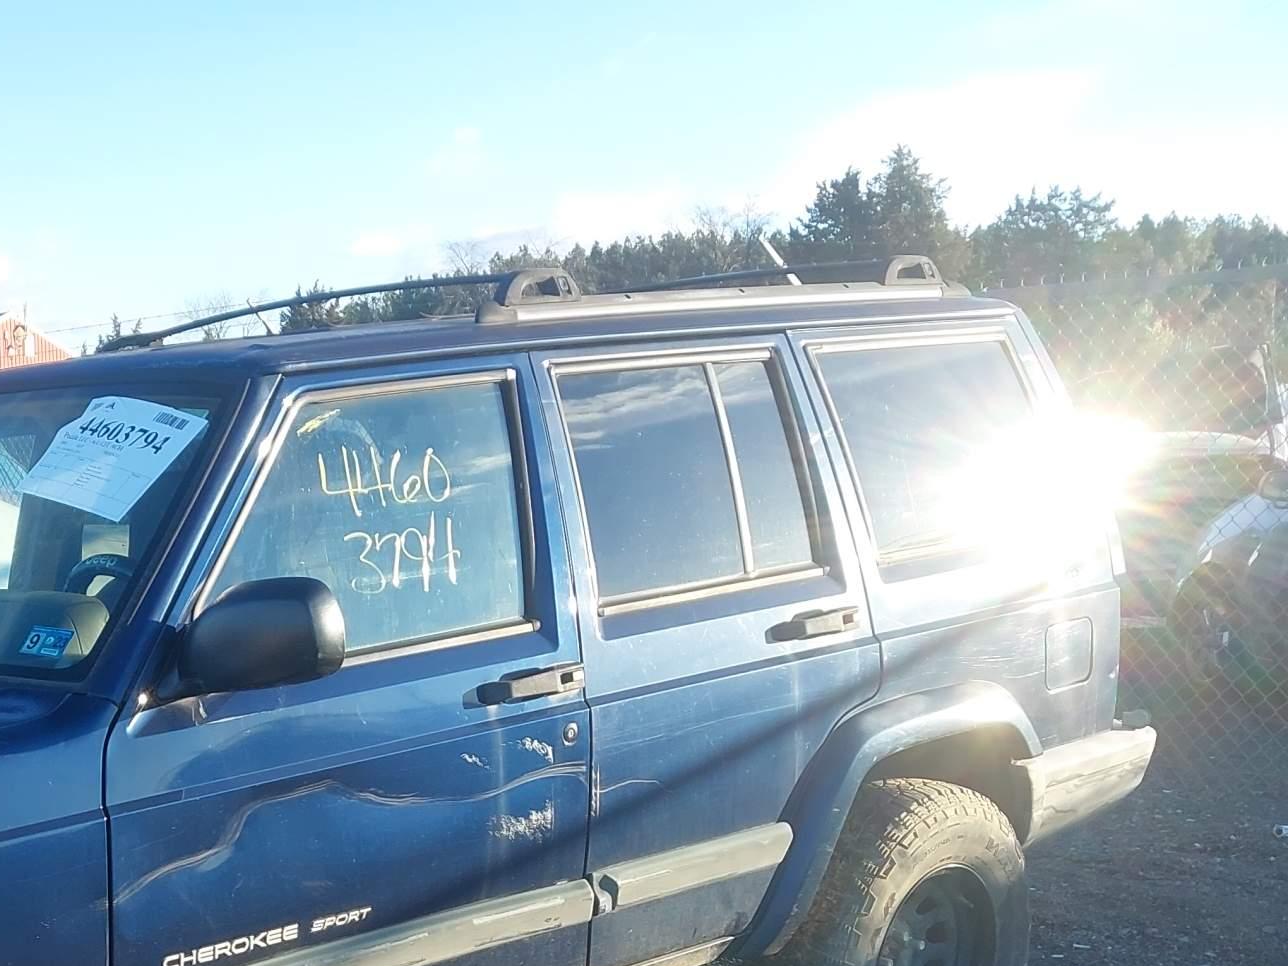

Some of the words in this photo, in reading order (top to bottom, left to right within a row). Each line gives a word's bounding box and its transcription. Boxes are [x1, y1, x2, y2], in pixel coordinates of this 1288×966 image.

[78, 416, 172, 455] 44603794
[317, 445, 451, 517] 4460
[343, 510, 462, 594] 3794
[26, 633, 42, 650] 9
[310, 907, 372, 933] SPORT
